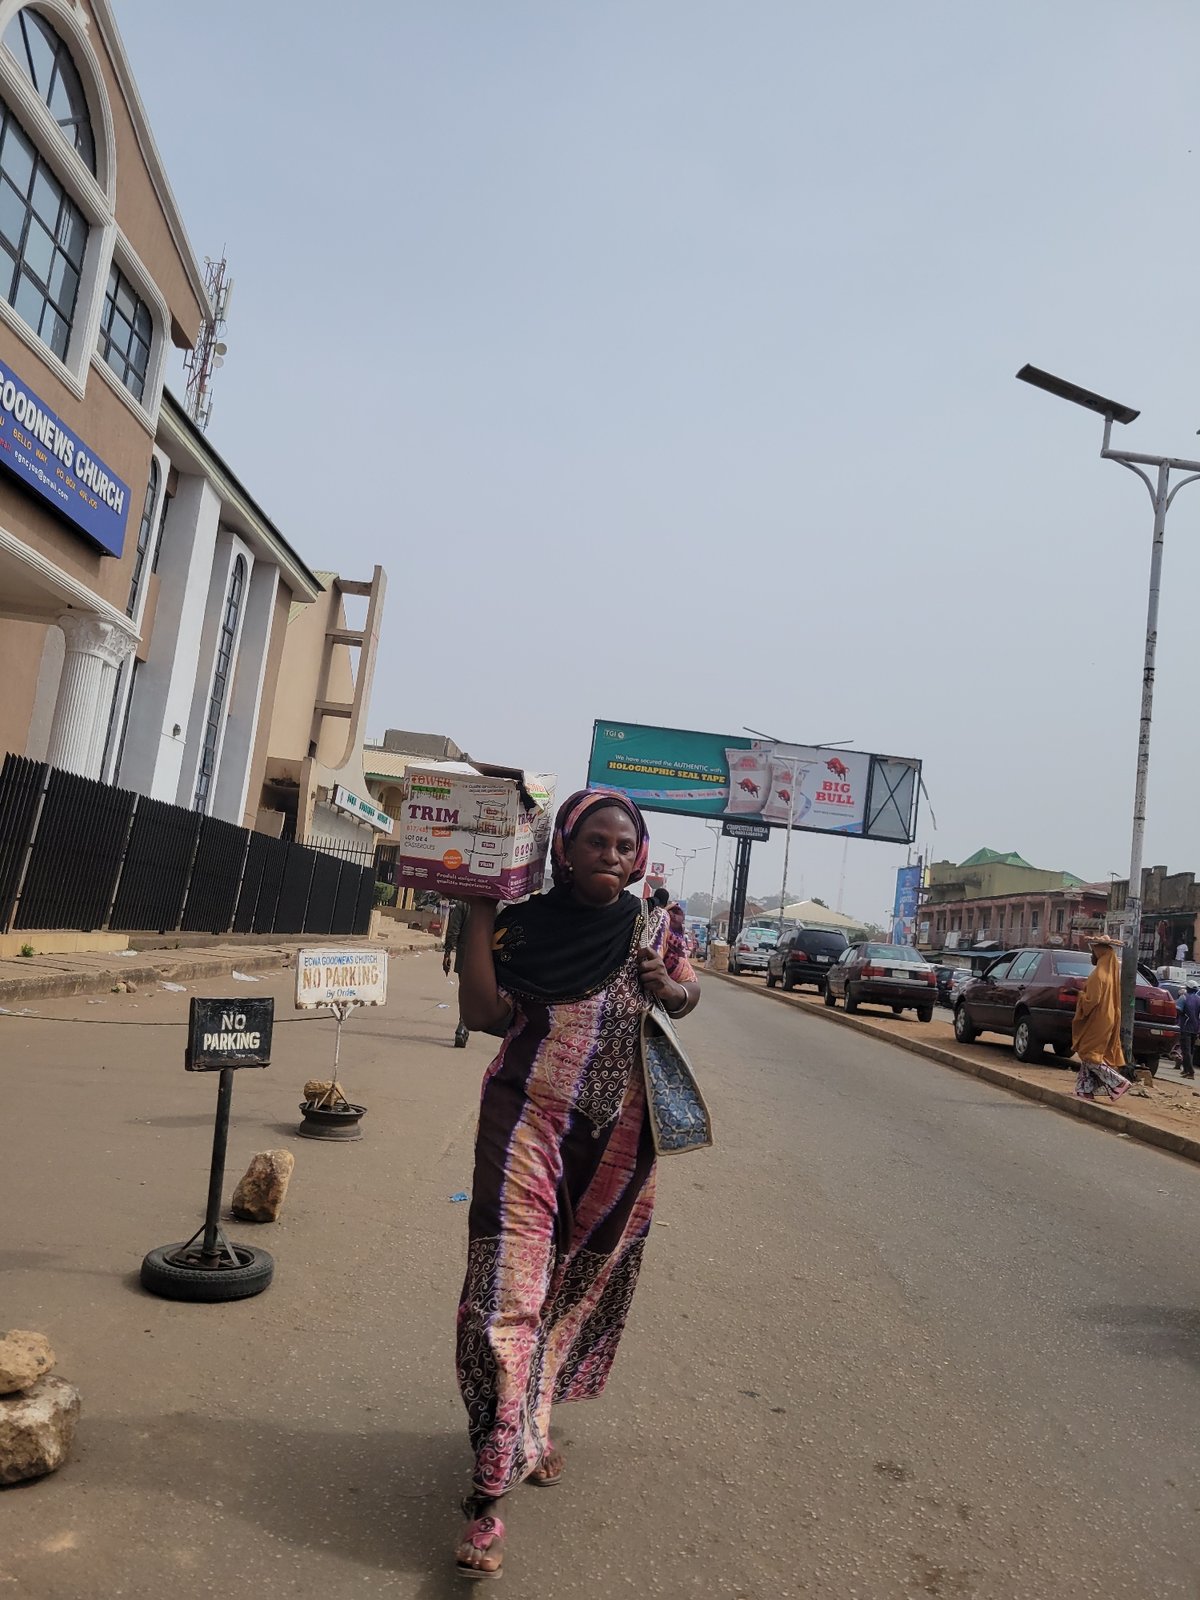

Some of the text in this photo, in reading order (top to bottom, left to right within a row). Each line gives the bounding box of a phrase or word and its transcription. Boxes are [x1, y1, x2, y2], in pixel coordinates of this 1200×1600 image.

[12, 428, 33, 450] BELLO
[76, 450, 125, 515] CHURCH
[604, 729, 617, 737] TGI
[608, 761, 726, 783] HOLOGRAPHIC SEAL TAPE
[626, 755, 640, 763] have
[641, 758, 662, 766] secured
[673, 761, 709, 772] AUTHENTIC
[823, 780, 851, 793] BIG
[814, 791, 855, 805] BULL
[407, 804, 459, 824] TRIM
[355, 954, 378, 965] CHURCH
[303, 965, 379, 989] NO PARKING
[326, 988, 356, 998] By Order
[221, 1013, 247, 1031] NO
[203, 1031, 261, 1051] PARKING
